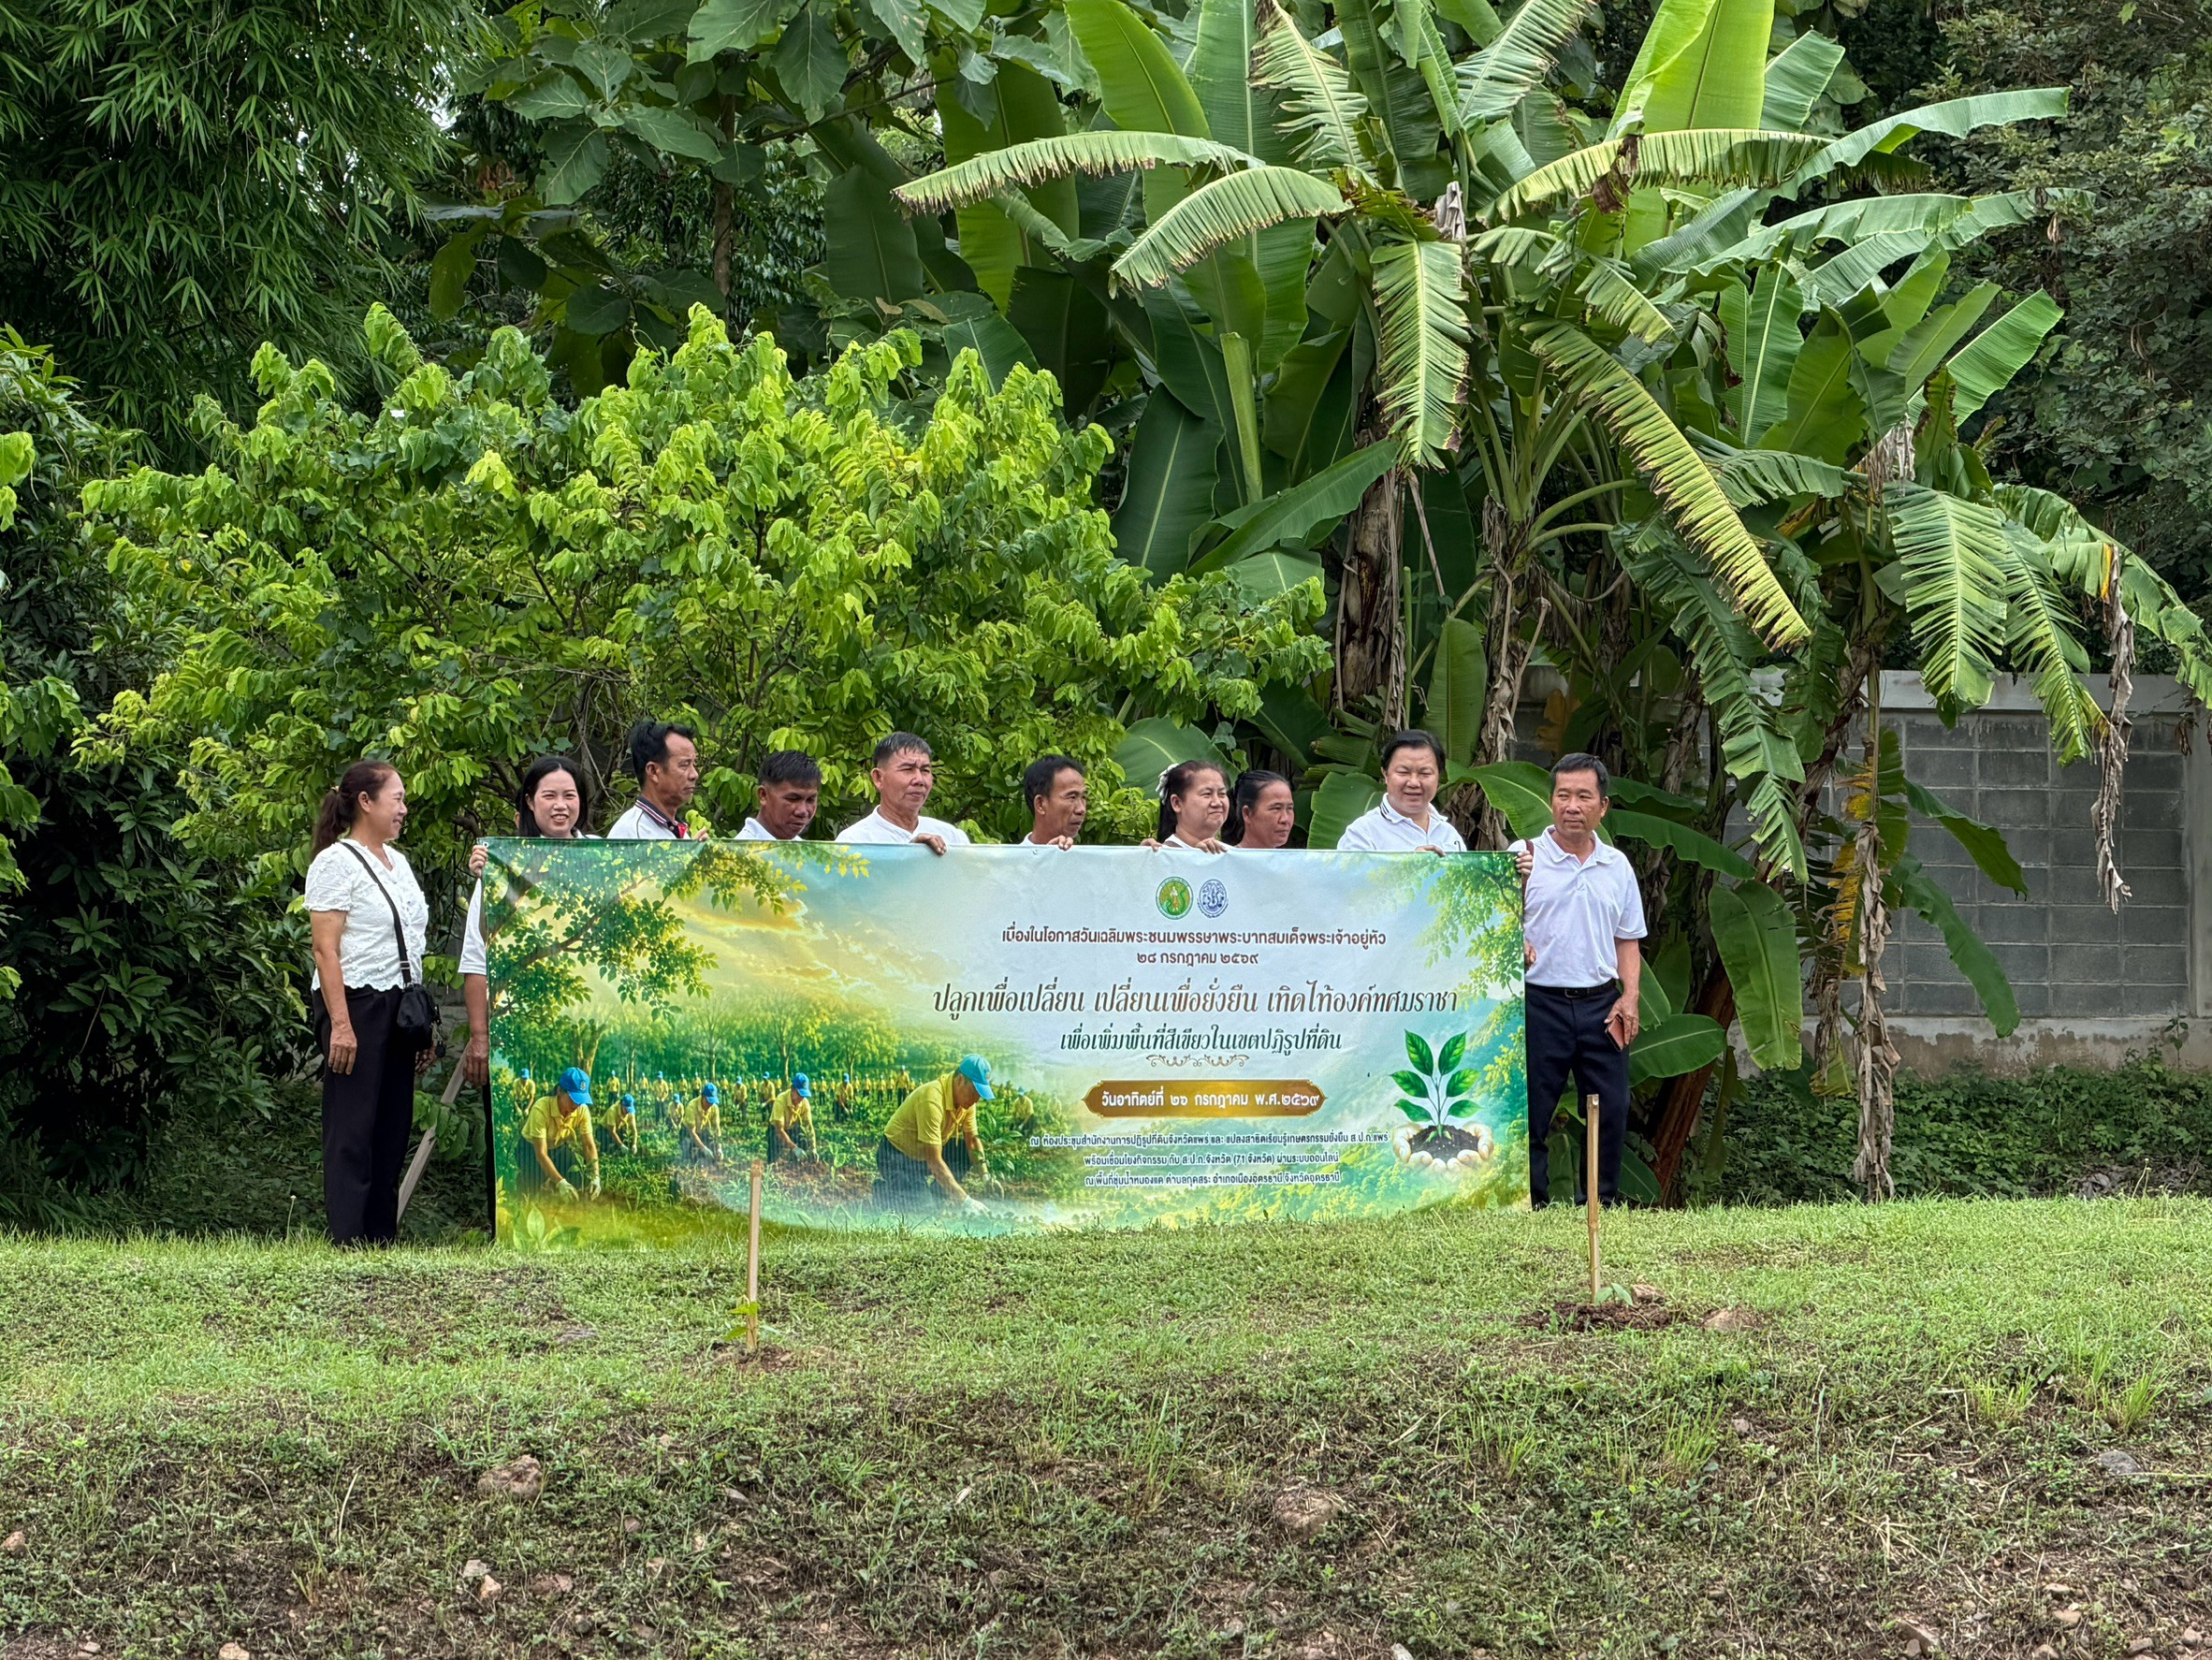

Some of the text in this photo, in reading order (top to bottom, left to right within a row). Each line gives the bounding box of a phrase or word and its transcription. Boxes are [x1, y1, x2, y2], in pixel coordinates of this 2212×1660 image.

[1002, 922, 1387, 950] เนื่องในโอกาสวันเฉลิมพระชนมพรรษาพระบาทสมเด็จพระเจ้าอยู่หัว
[1137, 953, 1259, 967] ๒๘ กรกฎาคม ๒๕๖๙
[934, 977, 1458, 1021] ปลูกเพื่อเปลี่ยน เปลี่ยนเพื่อยั่งยืน เทิดไท้องค์ทศมราชา
[1060, 1023, 1343, 1056] เพื่อเพิ่มพื้นที่สีเขียวในเขตปฏิรูปที่ดิน
[1101, 1085, 1164, 1107] วันอาทิตย์ที่
[1195, 1093, 1248, 1109] กรกฎาคม
